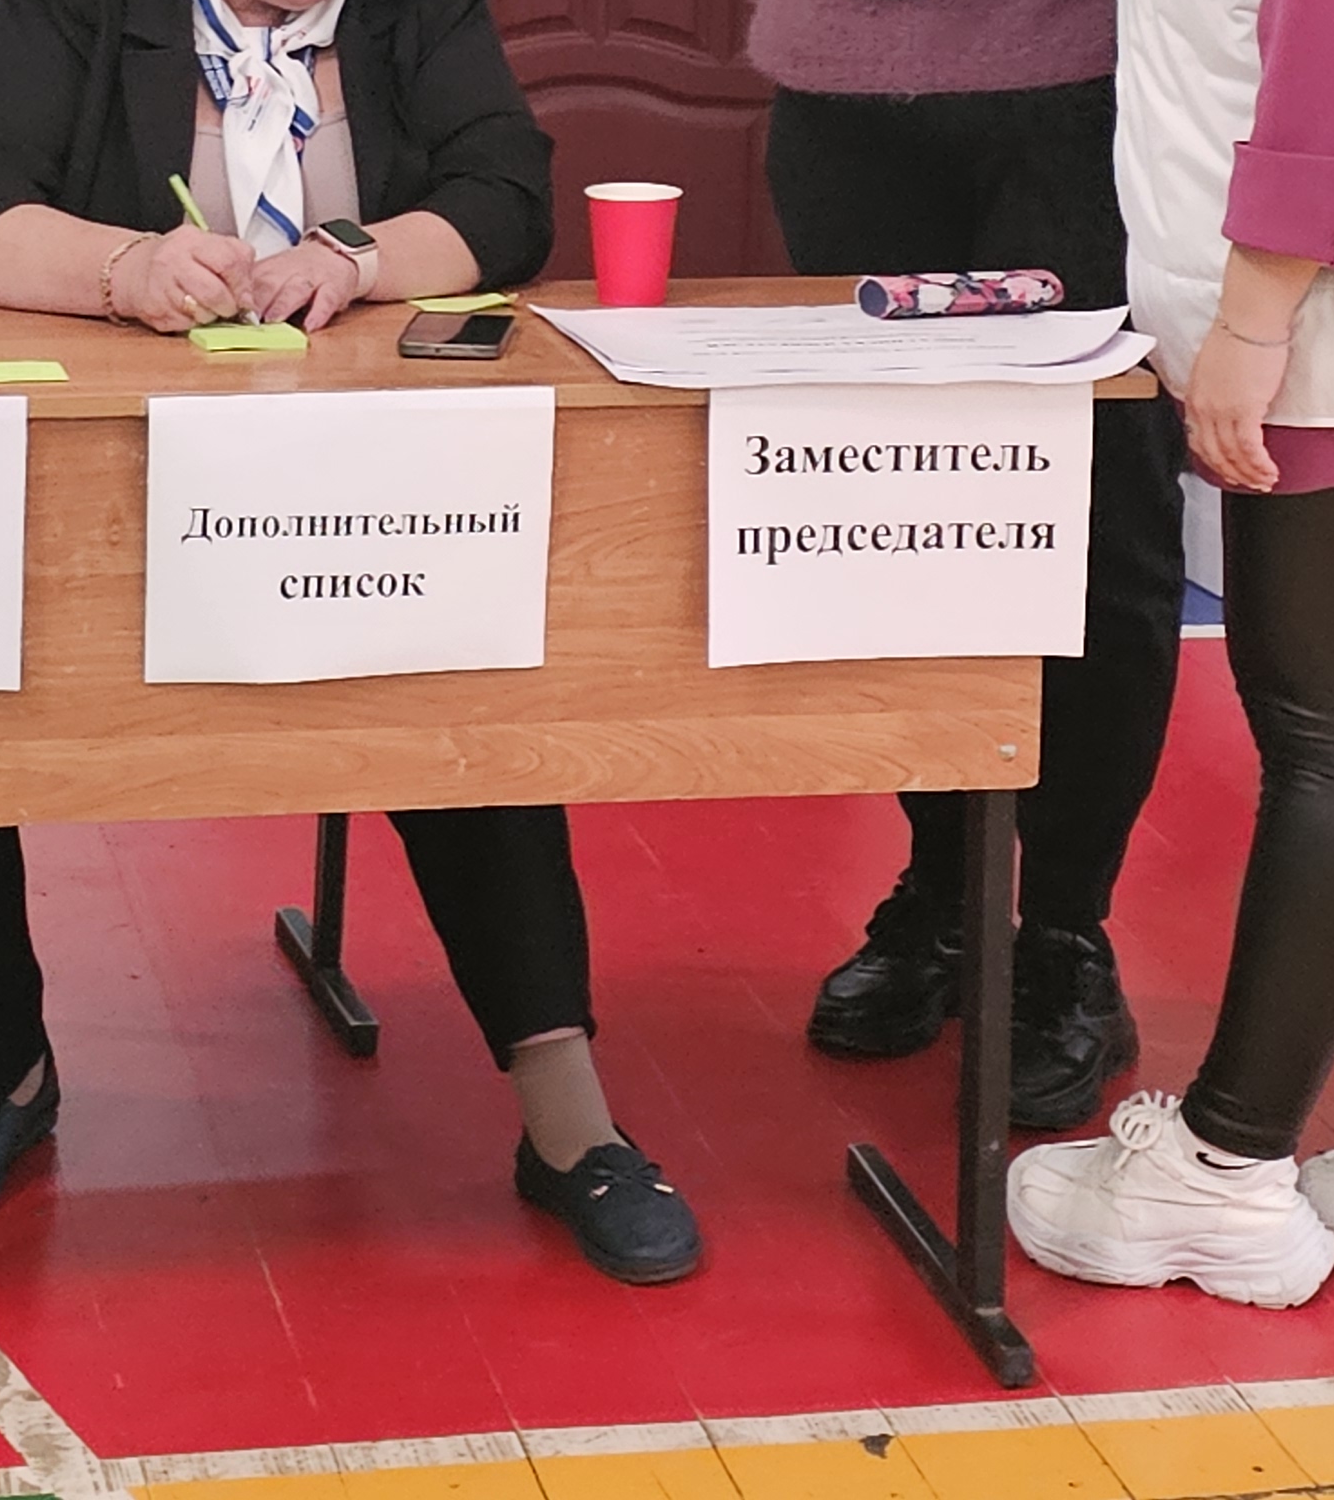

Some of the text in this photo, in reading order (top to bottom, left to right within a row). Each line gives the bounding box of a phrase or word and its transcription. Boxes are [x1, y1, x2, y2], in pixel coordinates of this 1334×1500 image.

[744, 434, 1052, 476] Заместитель
[180, 502, 523, 545] Дополнительный
[736, 520, 1057, 566] председателя
[278, 571, 427, 600] список
